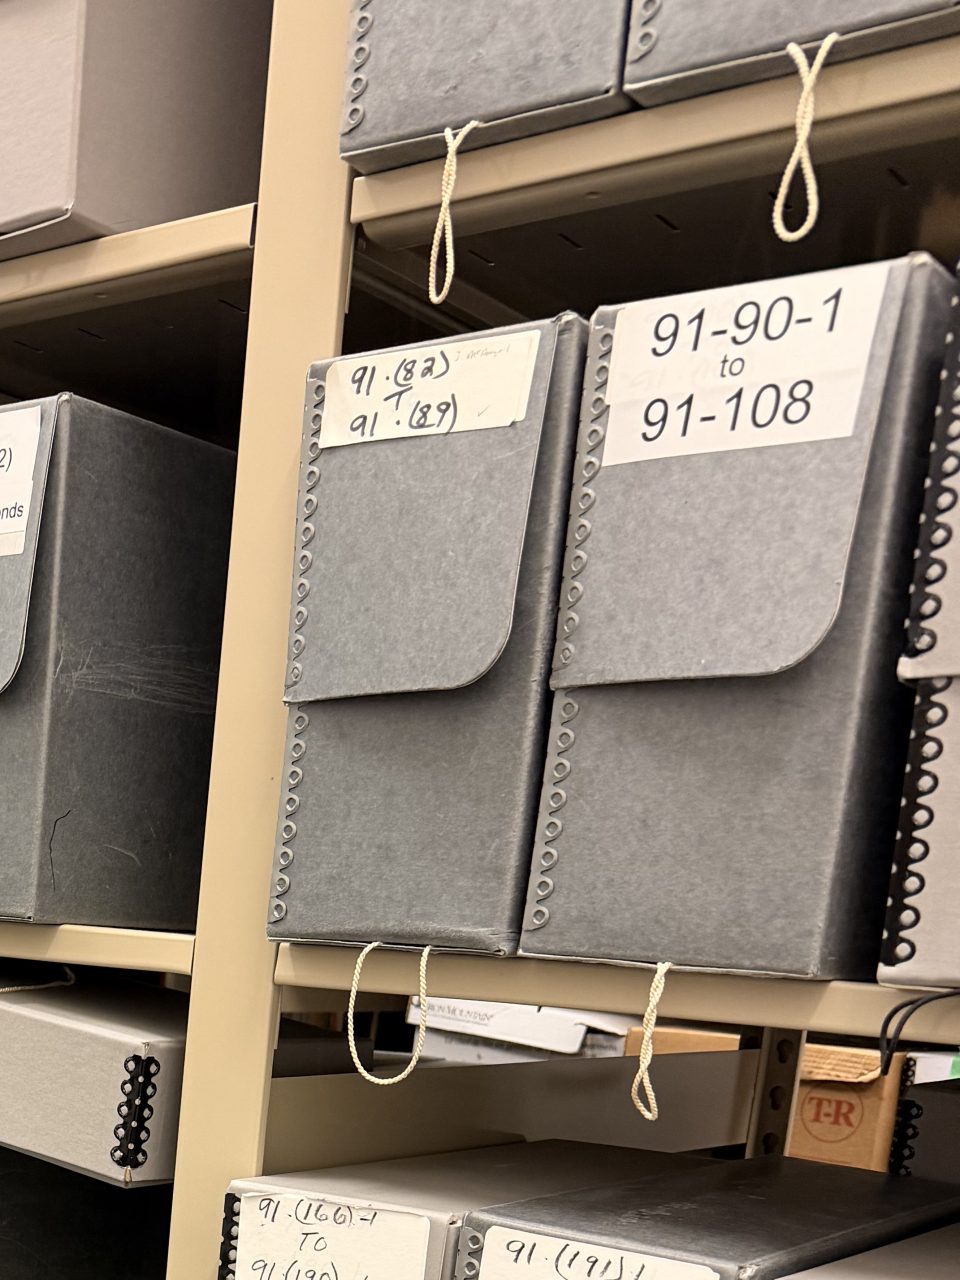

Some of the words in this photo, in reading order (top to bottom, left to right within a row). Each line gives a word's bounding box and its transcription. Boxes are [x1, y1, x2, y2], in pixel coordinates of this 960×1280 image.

[652, 287, 844, 359] 91-90-1
[720, 352, 746, 378] to
[641, 379, 814, 442] 91-108
[807, 1094, 856, 1128] T-R
[298, 1231, 328, 1252] TO
